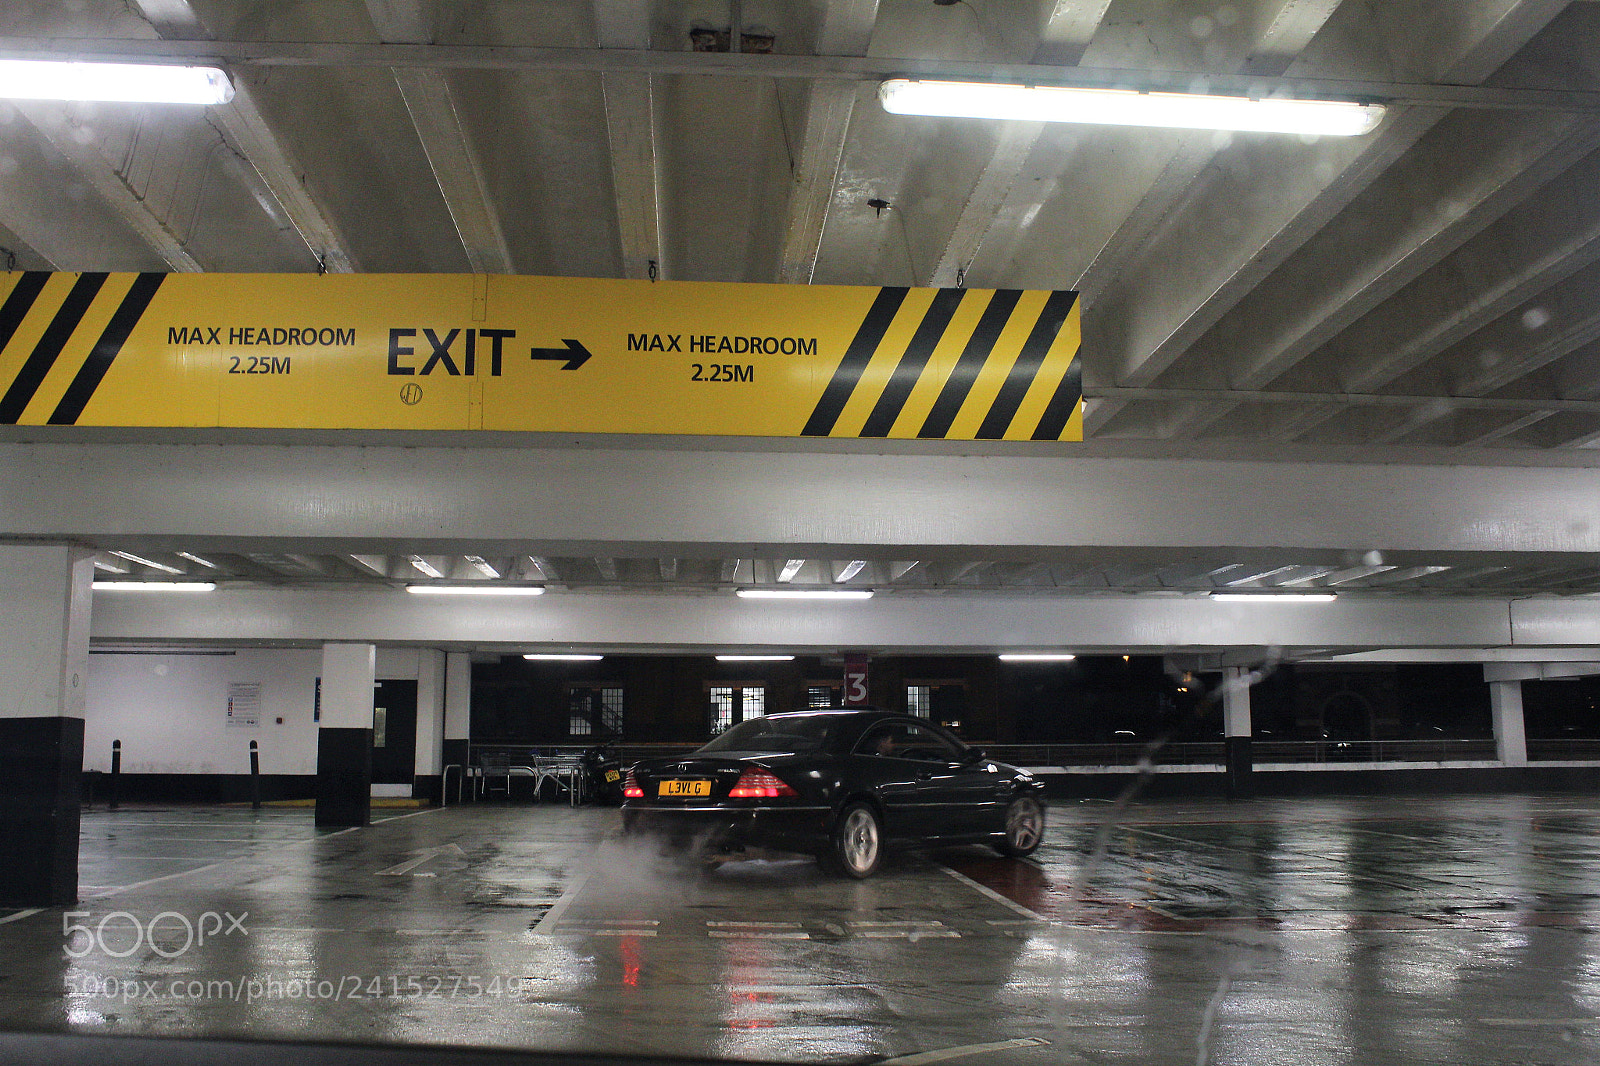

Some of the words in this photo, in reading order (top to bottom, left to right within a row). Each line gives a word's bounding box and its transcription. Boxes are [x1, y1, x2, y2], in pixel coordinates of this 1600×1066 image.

[167, 327, 221, 345] MAX
[229, 327, 356, 346] HEADROOM
[627, 333, 682, 353] MAX
[689, 334, 817, 356] HEADROOM
[387, 328, 517, 377] EXIT
[228, 357, 291, 375] 2.25M
[691, 363, 754, 383] 2.25M
[848, 673, 867, 701] 3
